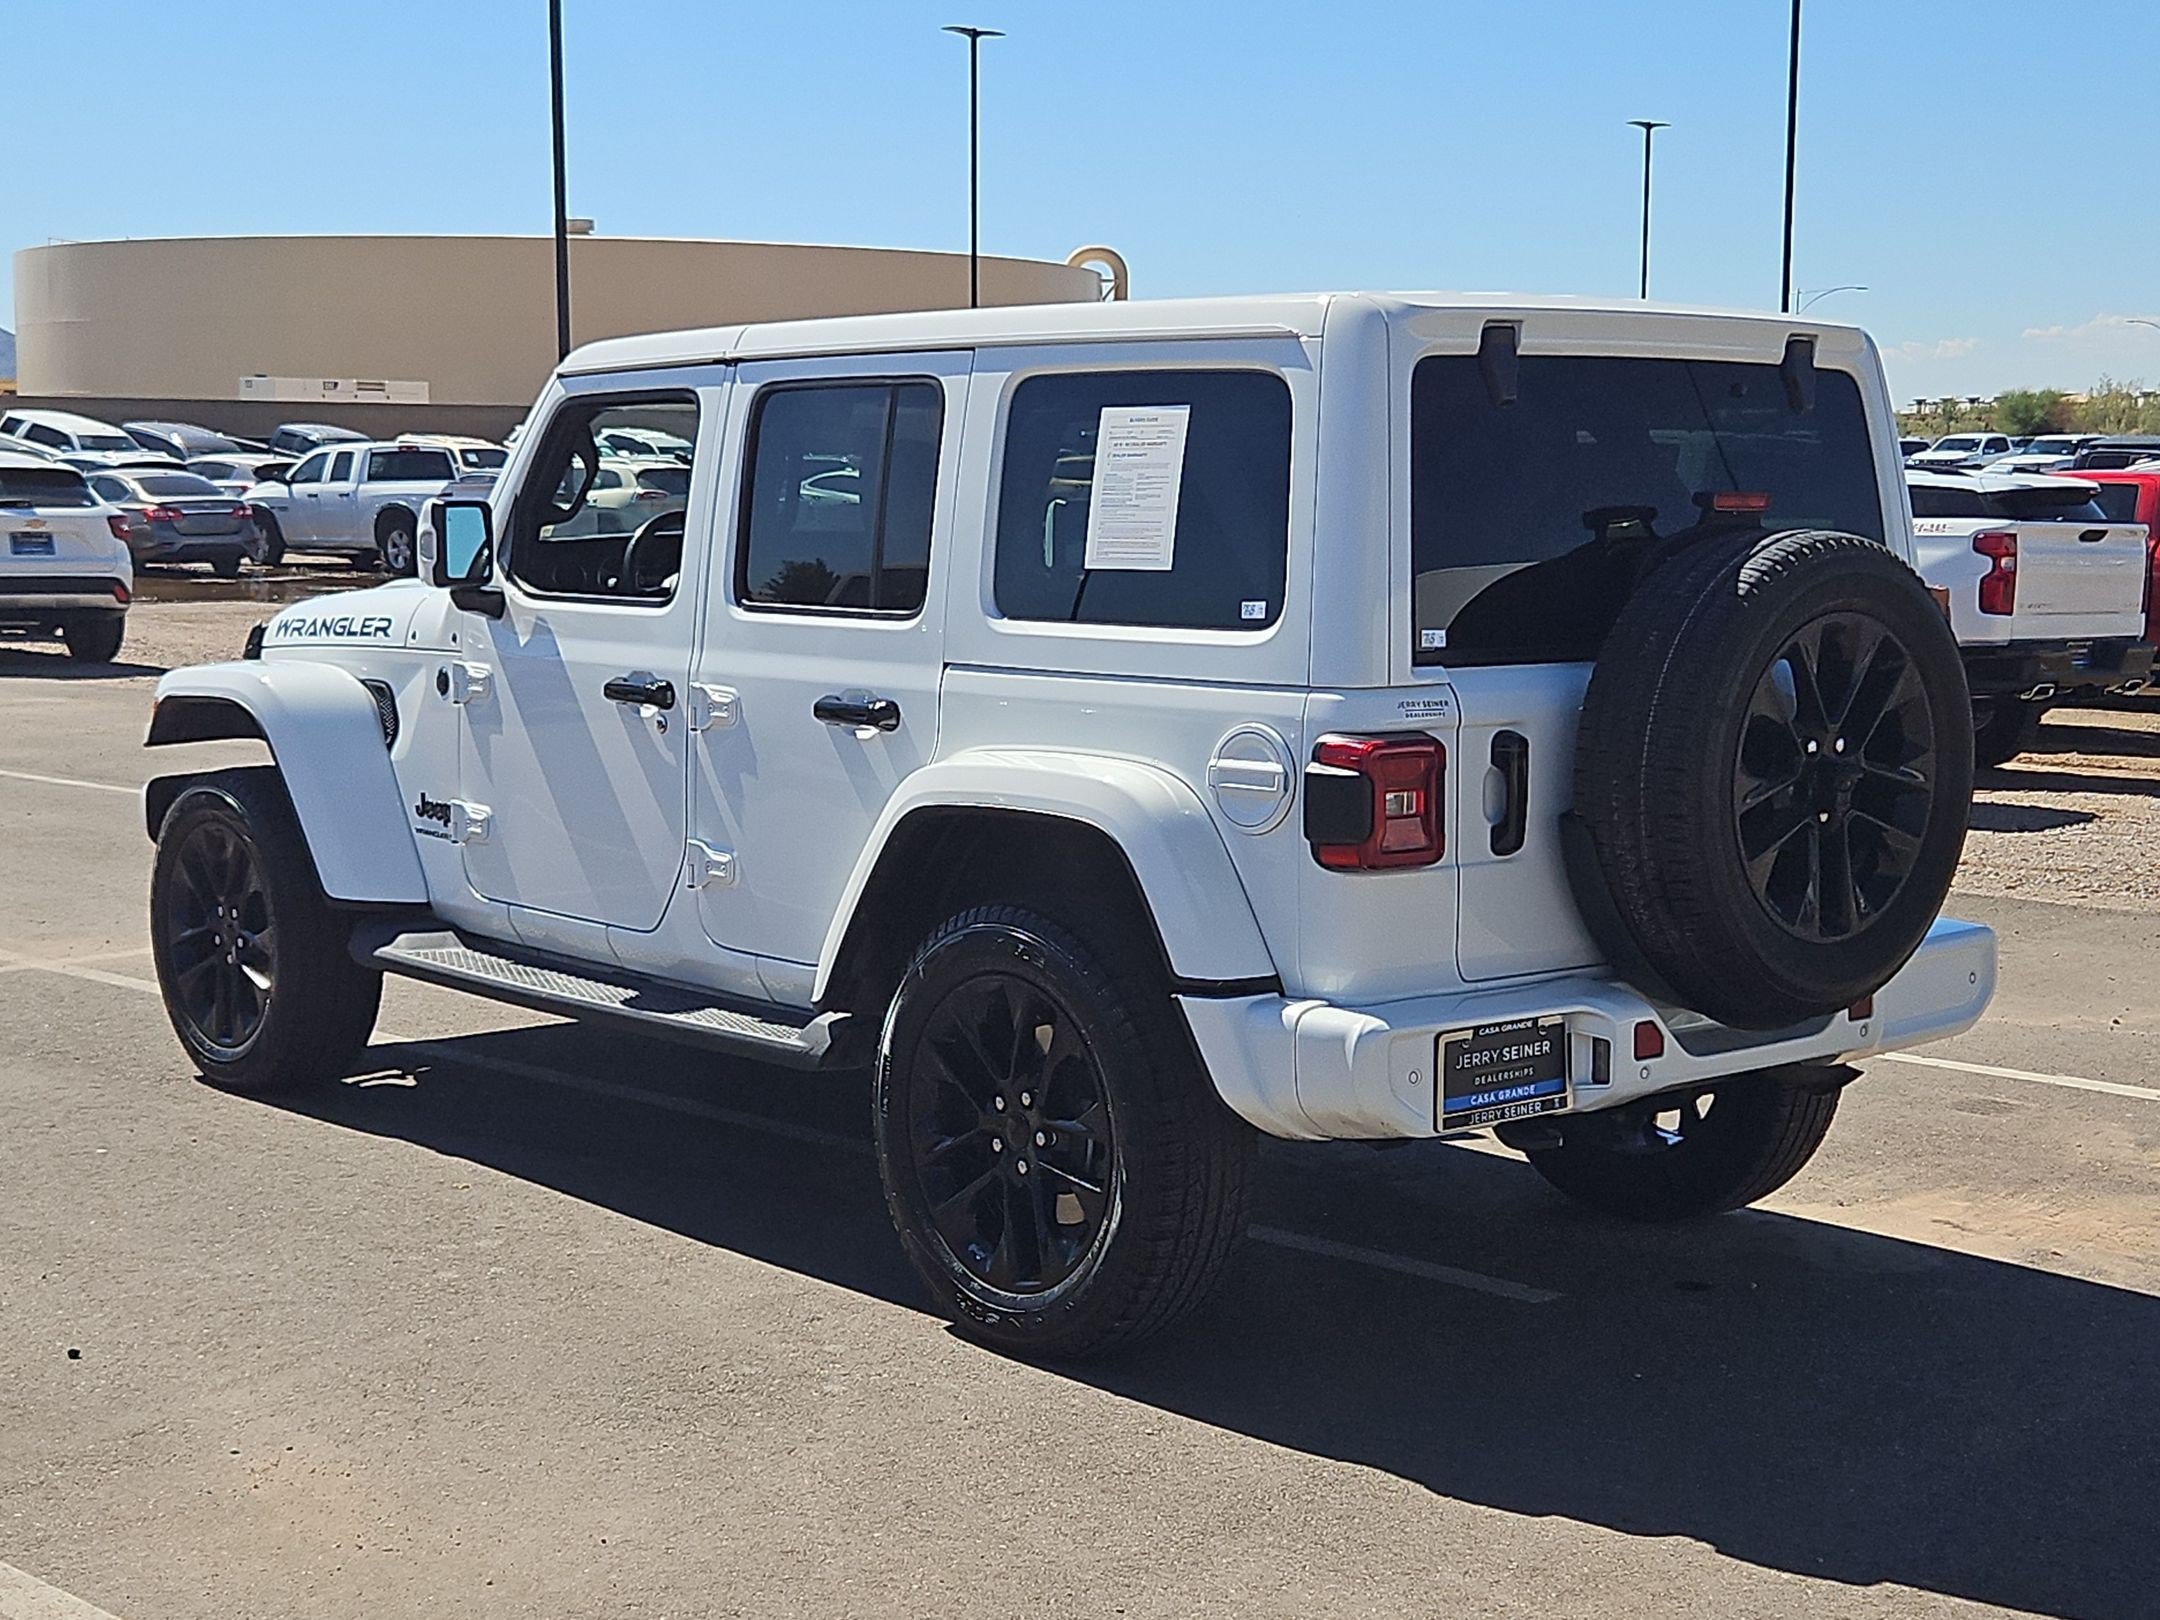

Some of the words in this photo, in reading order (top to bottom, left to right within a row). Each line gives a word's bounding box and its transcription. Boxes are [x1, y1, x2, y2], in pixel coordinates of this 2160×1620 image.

[275, 617, 392, 637] WRANGLER
[1397, 699, 1421, 709] JERRY
[1422, 699, 1450, 708] SEINER
[415, 792, 452, 828] Jeep
[1478, 1026, 1500, 1036] CASA
[1501, 1020, 1534, 1033] GRANDE
[1455, 1049, 1501, 1070] JERRY
[1502, 1040, 1551, 1061] SEINER
[1474, 1067, 1534, 1085] DEALERSHIPS
[1470, 1093, 1498, 1105] CASA
[1498, 1085, 1536, 1101] GRANDE
[1468, 1110, 1502, 1125] JERRY
[1504, 1102, 1542, 1119] SEINER
